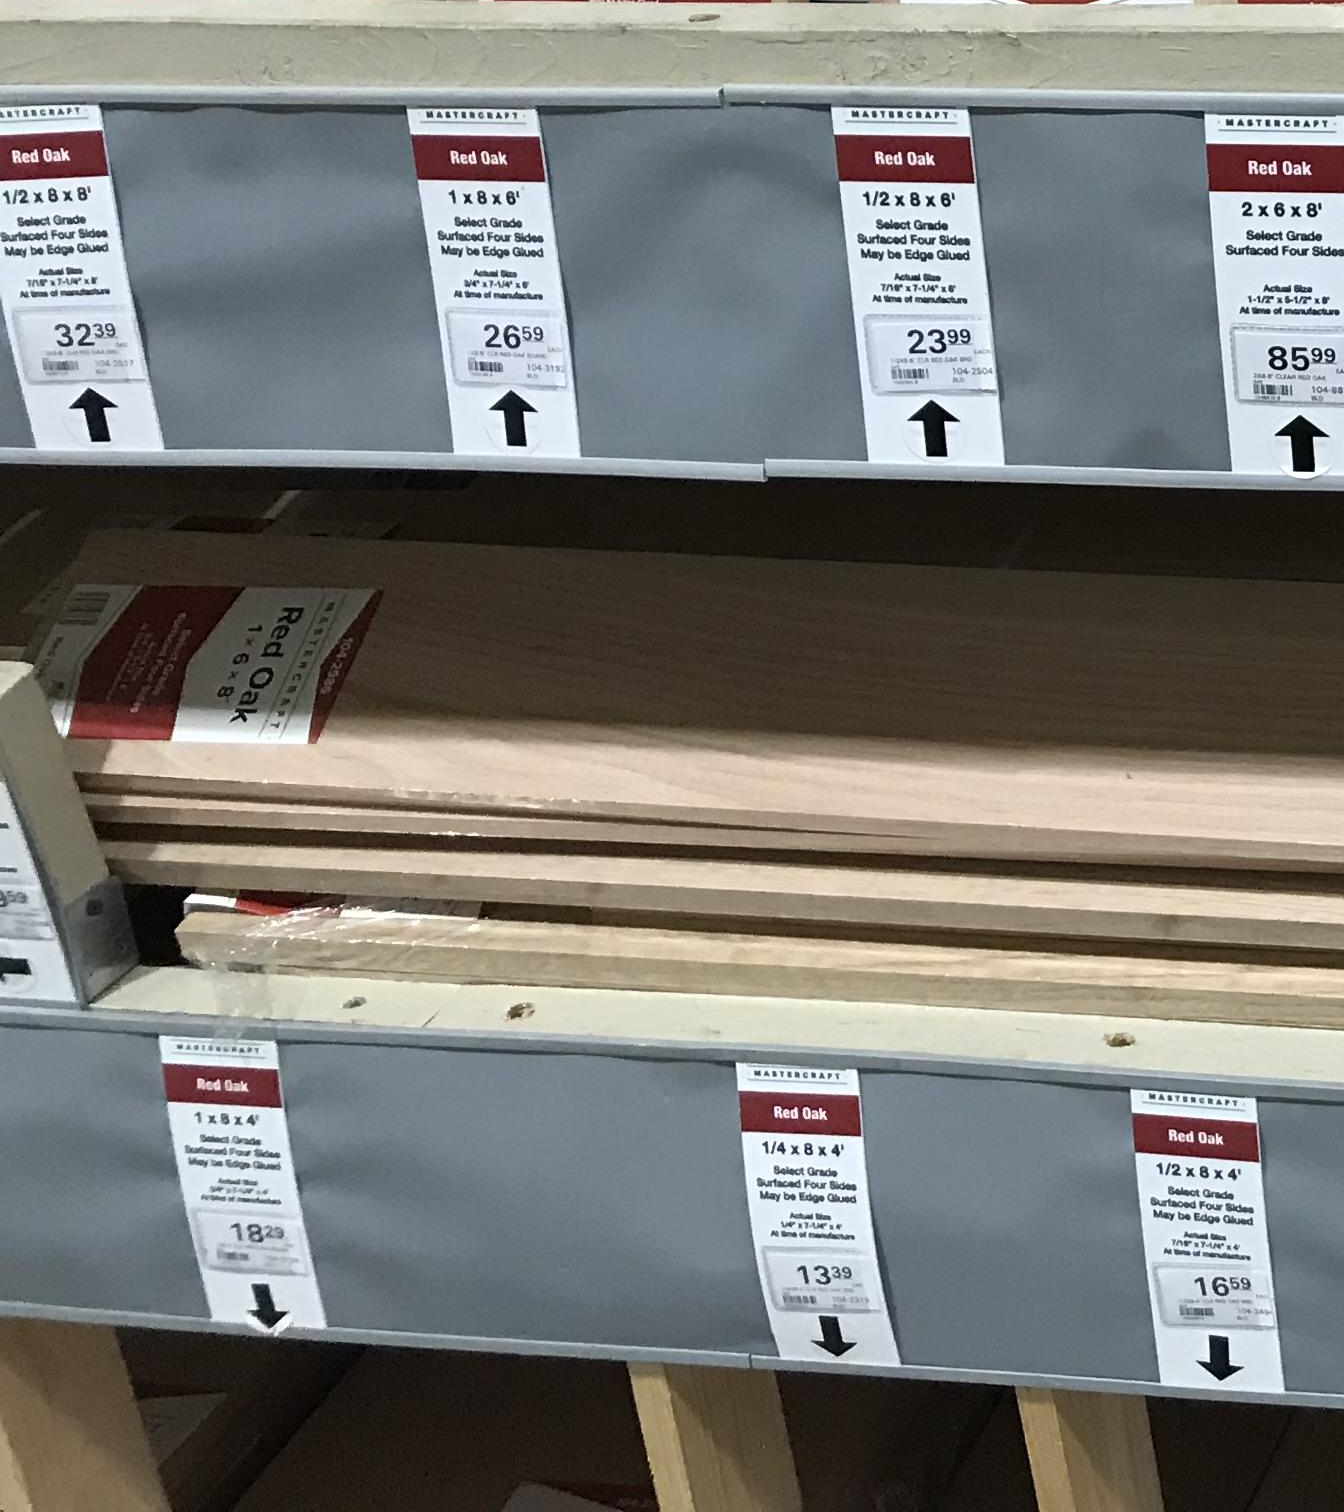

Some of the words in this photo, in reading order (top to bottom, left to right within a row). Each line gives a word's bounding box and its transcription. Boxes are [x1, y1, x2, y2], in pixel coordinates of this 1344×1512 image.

[12, 150, 39, 163] Red
[43, 149, 71, 162] Oak
[450, 151, 477, 165] Red
[481, 151, 508, 165] Oak
[874, 151, 902, 165] Red
[907, 152, 935, 166] Oak
[1248, 161, 1277, 175] Red
[1282, 162, 1312, 176] Oak
[261, 606, 304, 659] Red
[229, 666, 274, 724] Oak
[774, 1106, 798, 1119] Red
[802, 1107, 827, 1120] Oak
[1168, 1129, 1194, 1143] Red
[1198, 1131, 1224, 1146] Oak
